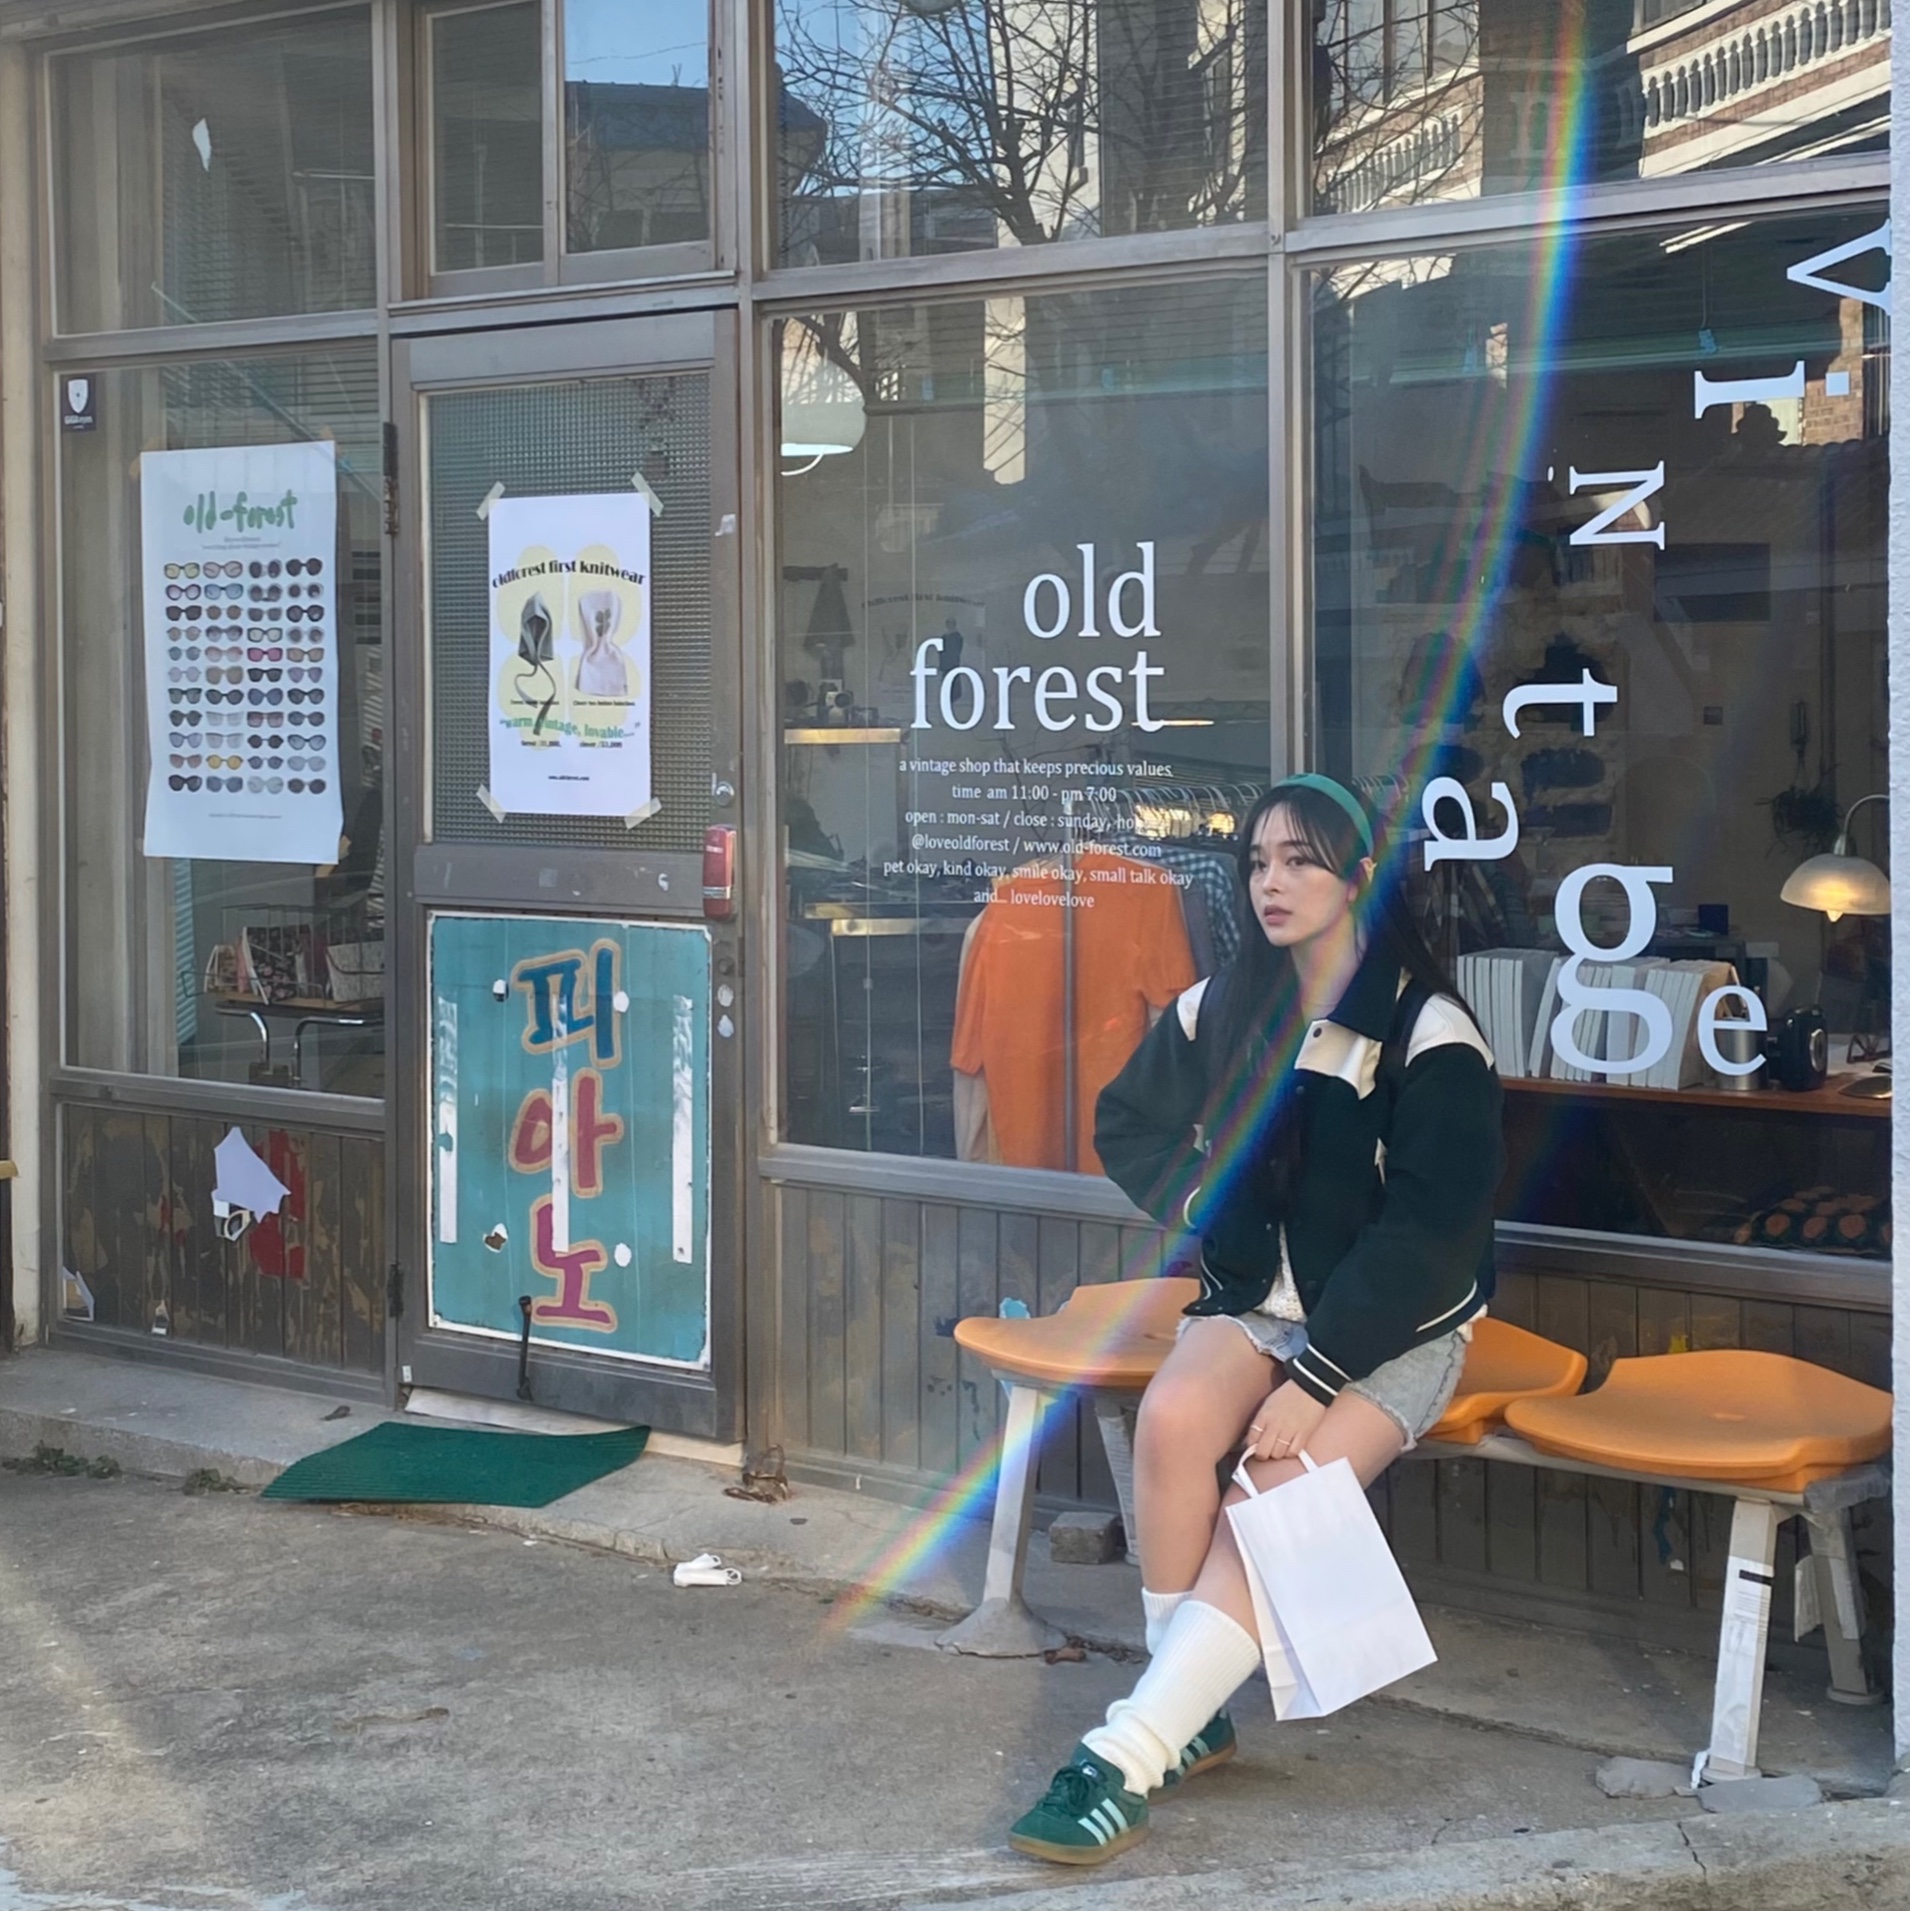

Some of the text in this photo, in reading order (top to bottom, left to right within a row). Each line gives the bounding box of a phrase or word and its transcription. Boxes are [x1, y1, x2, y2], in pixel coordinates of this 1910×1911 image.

[183, 488, 298, 534] old-forest
[492, 560, 646, 588] oldforest first knitwear
[1023, 541, 1161, 638] old
[909, 638, 1165, 732] forest
[899, 760, 907, 772] a
[909, 758, 957, 777] vintage
[959, 757, 991, 777] shop
[994, 758, 1020, 774] that
[1023, 758, 1062, 778] keeps
[1065, 760, 1124, 778] precious
[952, 784, 982, 799] time
[987, 788, 1008, 799] am
[1012, 785, 1049, 800] 11:00
[1061, 789, 1084, 805] pm
[1086, 786, 1117, 802] 7:00
[905, 811, 937, 827] open
[947, 812, 1000, 825] mon-sat
[1014, 811, 1047, 826] close
[911, 834, 1009, 851] @loveoldforest
[1023, 839, 1161, 857] www.old-forest.com
[884, 860, 903, 876] pet
[906, 859, 940, 878] okay,
[943, 860, 972, 876] kind
[1012, 864, 1048, 879] smile
[1051, 865, 1086, 884] okay,
[1090, 867, 1126, 883] small
[1130, 869, 1156, 884] talk
[1160, 869, 1193, 889] okay
[1010, 889, 1095, 907] lovelovelove
[510, 940, 623, 1331] 피아노
